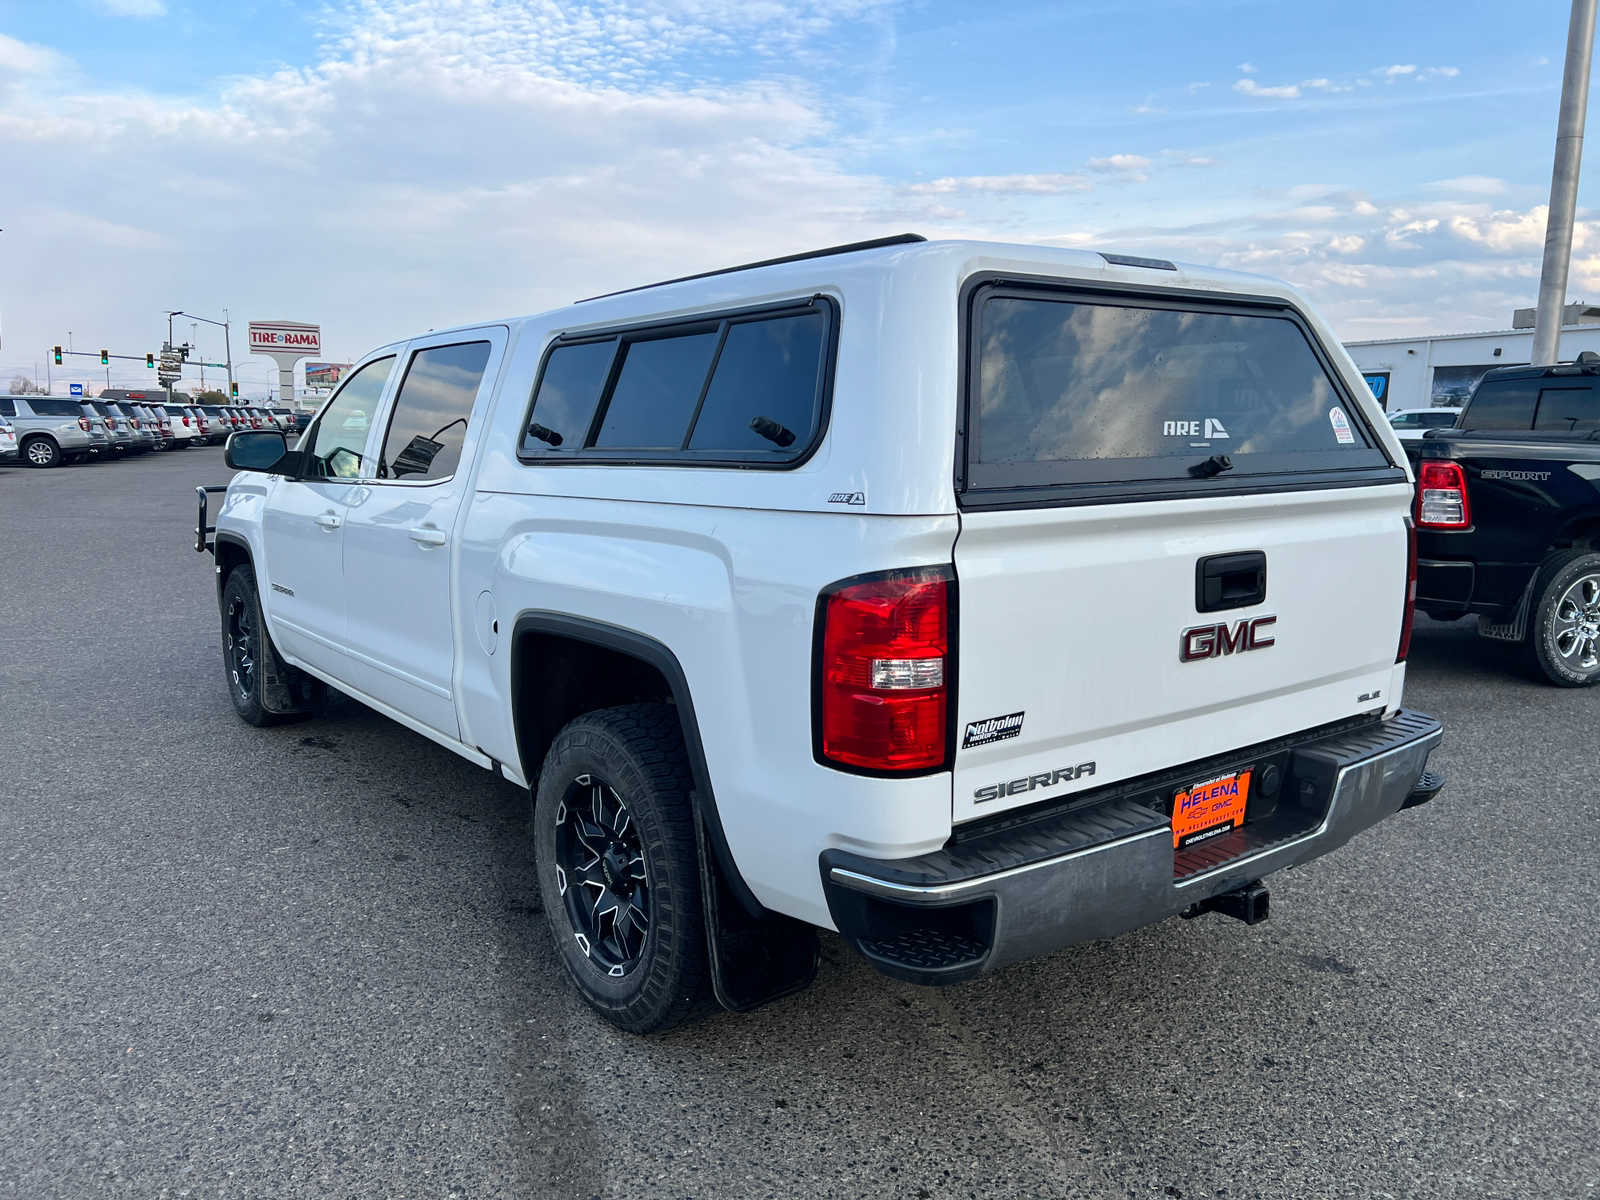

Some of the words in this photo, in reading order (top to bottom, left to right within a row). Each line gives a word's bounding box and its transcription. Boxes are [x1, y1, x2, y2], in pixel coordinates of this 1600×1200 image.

[251, 332, 277, 343] TIRE
[284, 334, 318, 345] RAMA
[1163, 421, 1200, 436] ARE
[1480, 469, 1552, 481] SPORT
[1179, 614, 1277, 663] GMC
[974, 761, 1096, 804] SIERRA
[1181, 782, 1239, 814] HELENA
[1211, 798, 1233, 812] GMC
